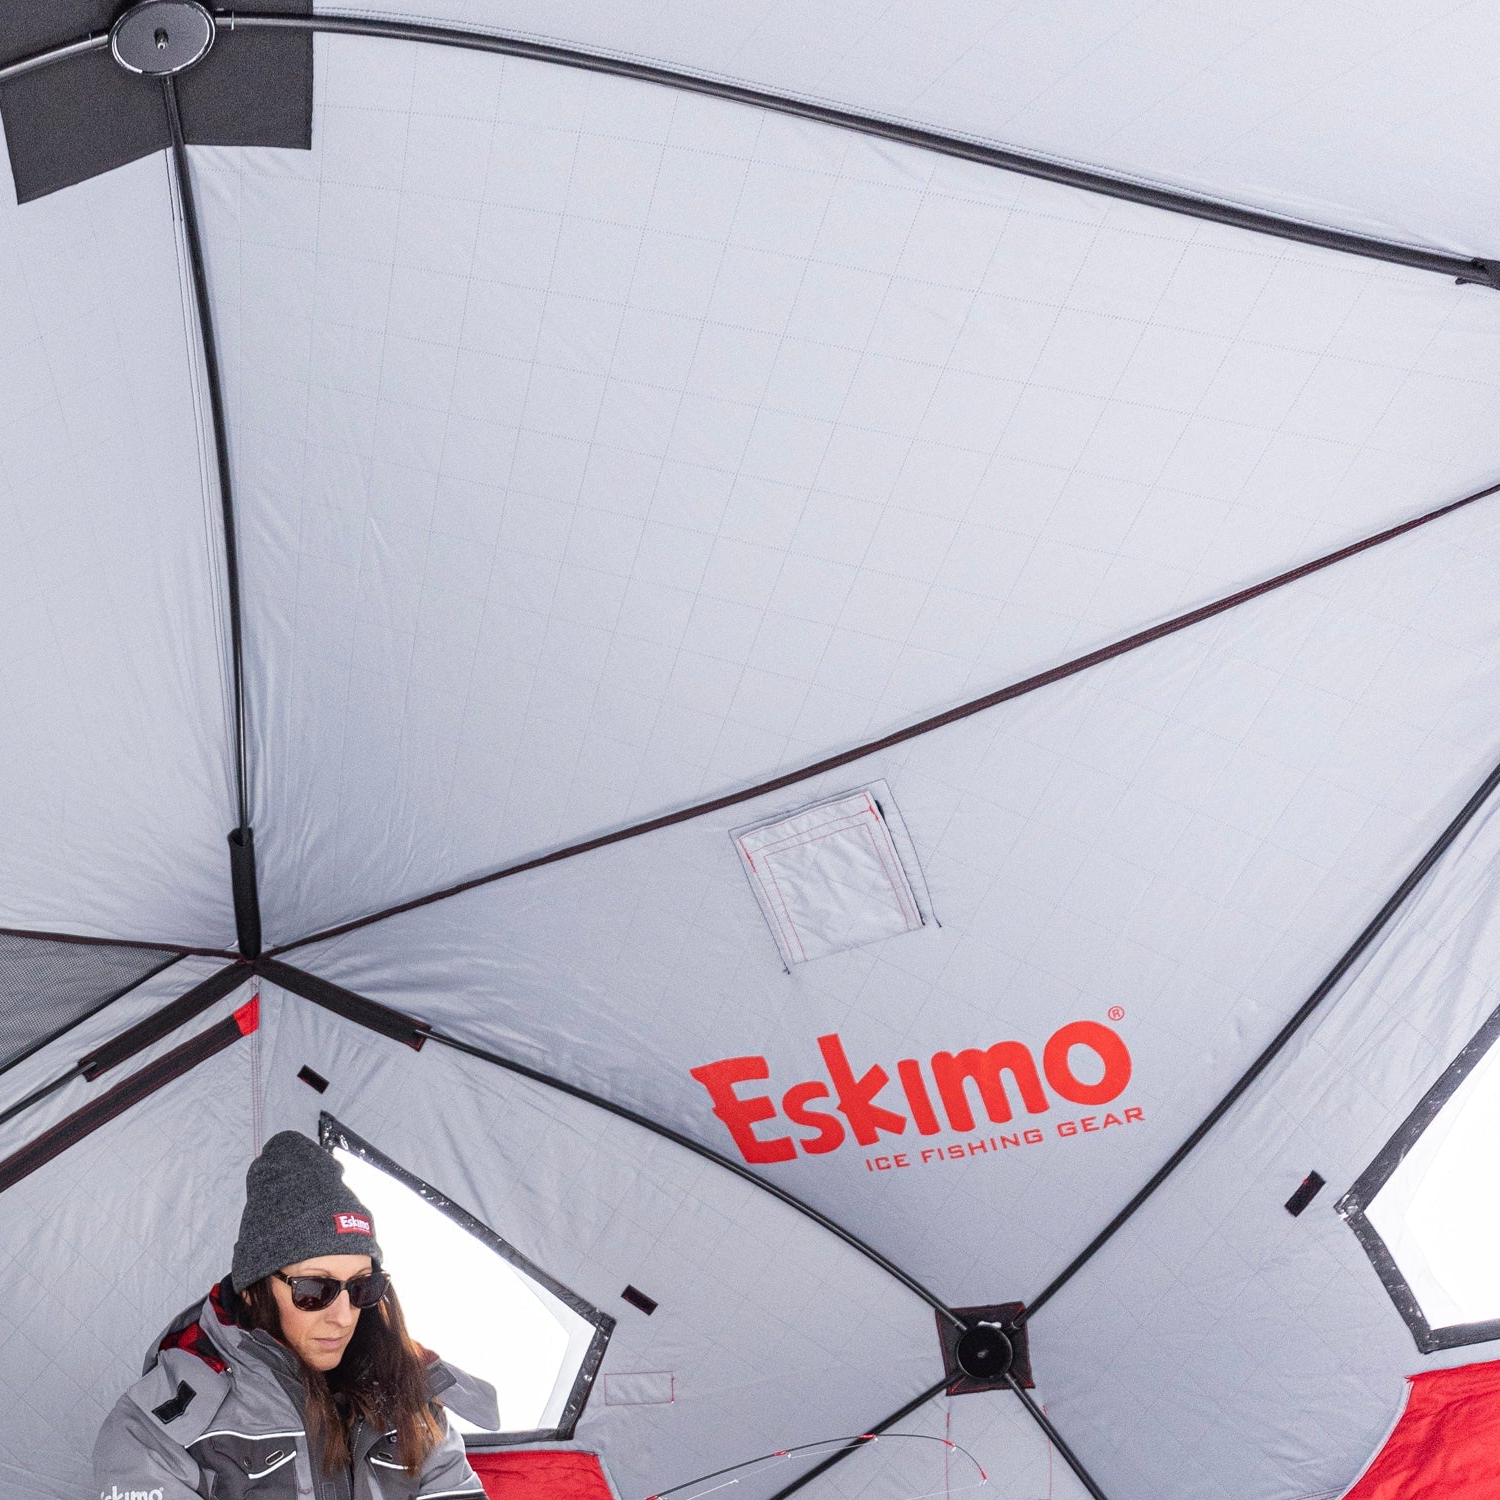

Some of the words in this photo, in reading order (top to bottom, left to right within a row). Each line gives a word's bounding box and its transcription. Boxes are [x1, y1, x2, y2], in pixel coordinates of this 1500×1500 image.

[866, 1154, 911, 1172] ICE
[920, 1129, 1044, 1164] FISHING
[1056, 1107, 1146, 1138] GEAR
[338, 1215, 370, 1230] Eskimo
